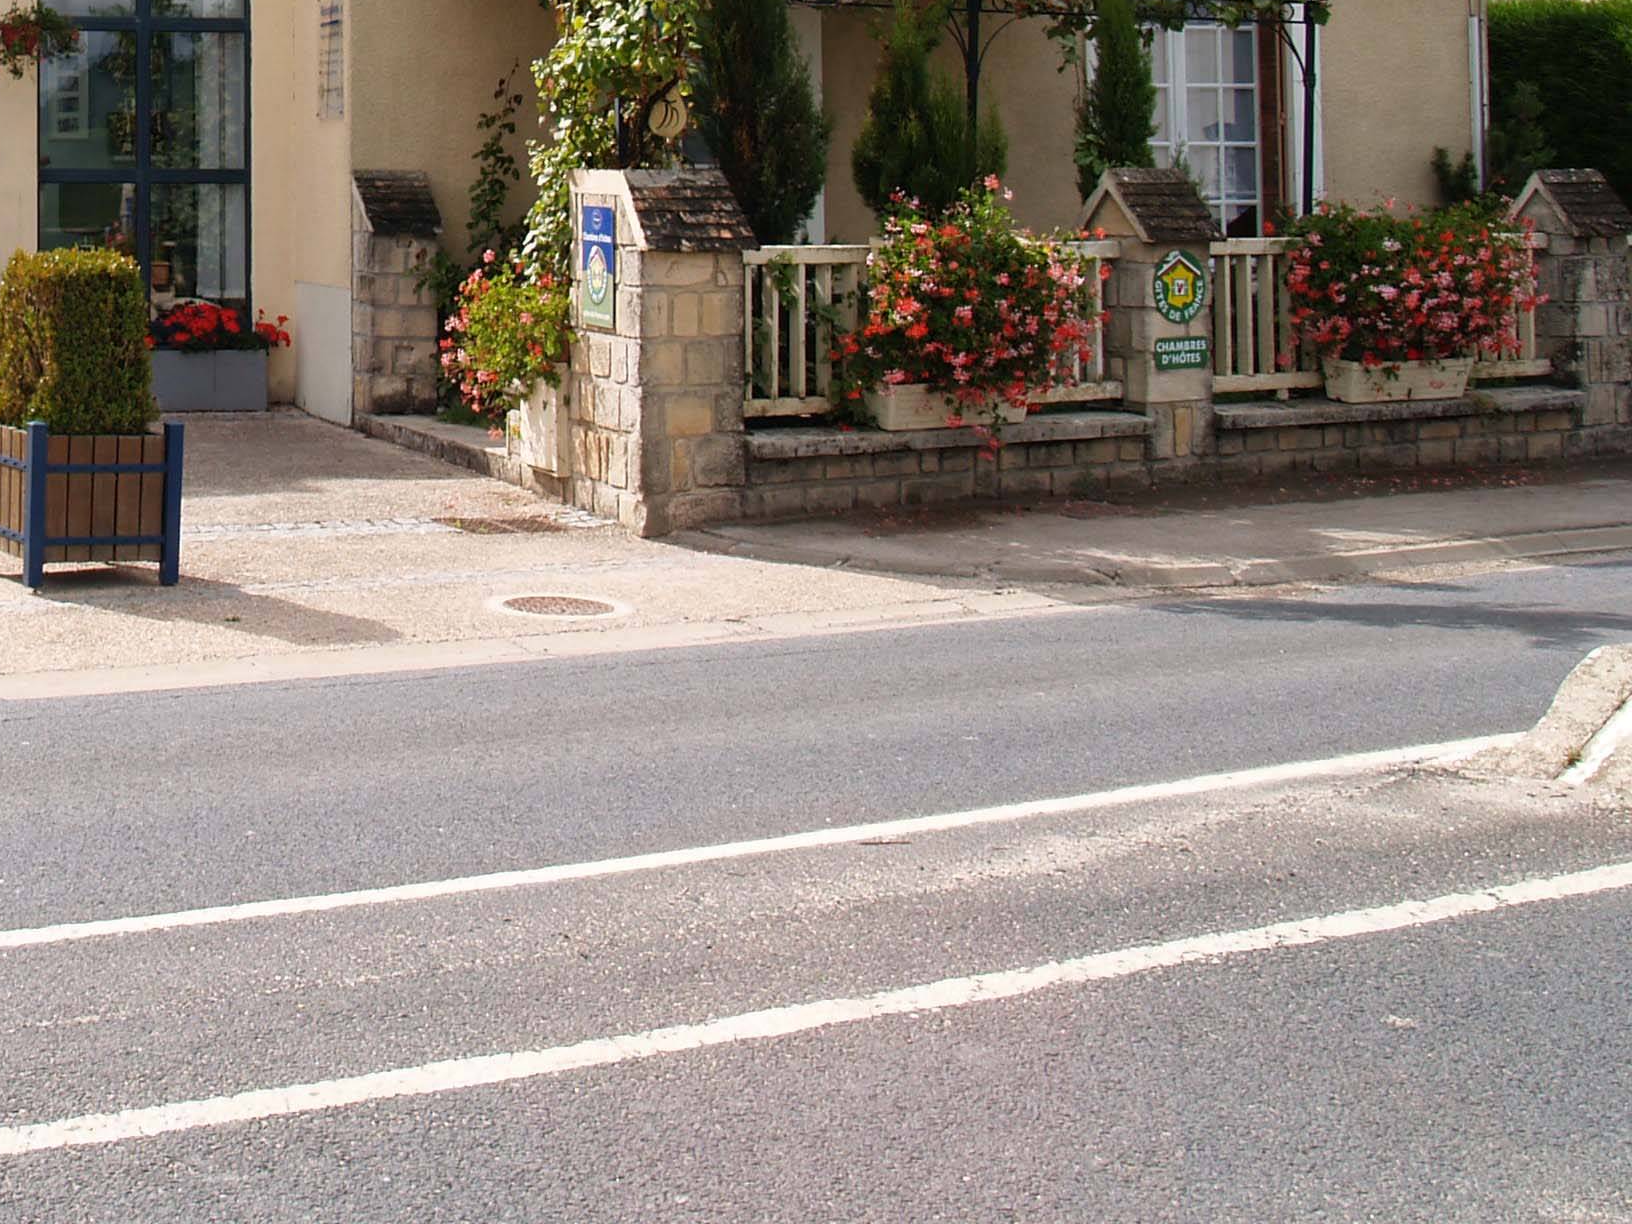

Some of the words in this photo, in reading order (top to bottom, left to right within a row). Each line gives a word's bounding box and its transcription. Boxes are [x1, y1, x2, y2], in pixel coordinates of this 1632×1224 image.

[1169, 310, 1181, 321] DE
[1184, 280, 1203, 319] FRANCE
[1156, 340, 1206, 352] CHAMBRES
[1162, 352, 1200, 364] D'HÔTES
